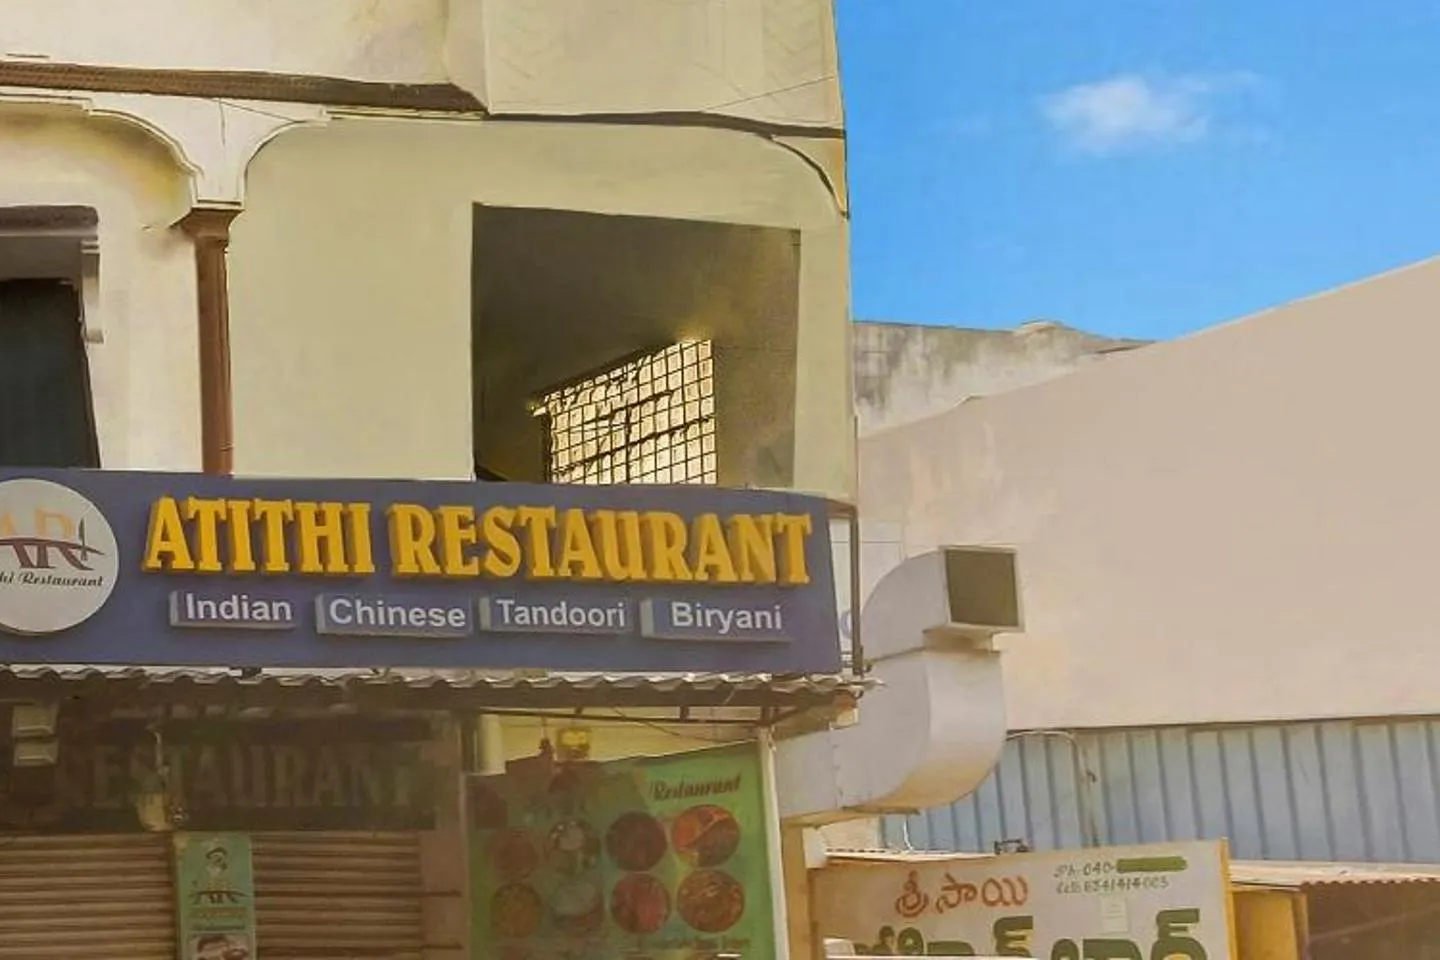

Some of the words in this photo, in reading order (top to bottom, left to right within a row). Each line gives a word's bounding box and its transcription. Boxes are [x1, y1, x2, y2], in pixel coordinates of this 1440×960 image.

[142, 496, 376, 574] ATITHI
[388, 503, 812, 584] RESTAURANT
[19, 572, 103, 587] Restaurant
[186, 593, 292, 621] Indian
[329, 598, 466, 627] Chinese
[496, 599, 625, 628] Tandoori
[671, 602, 783, 634] Biryani
